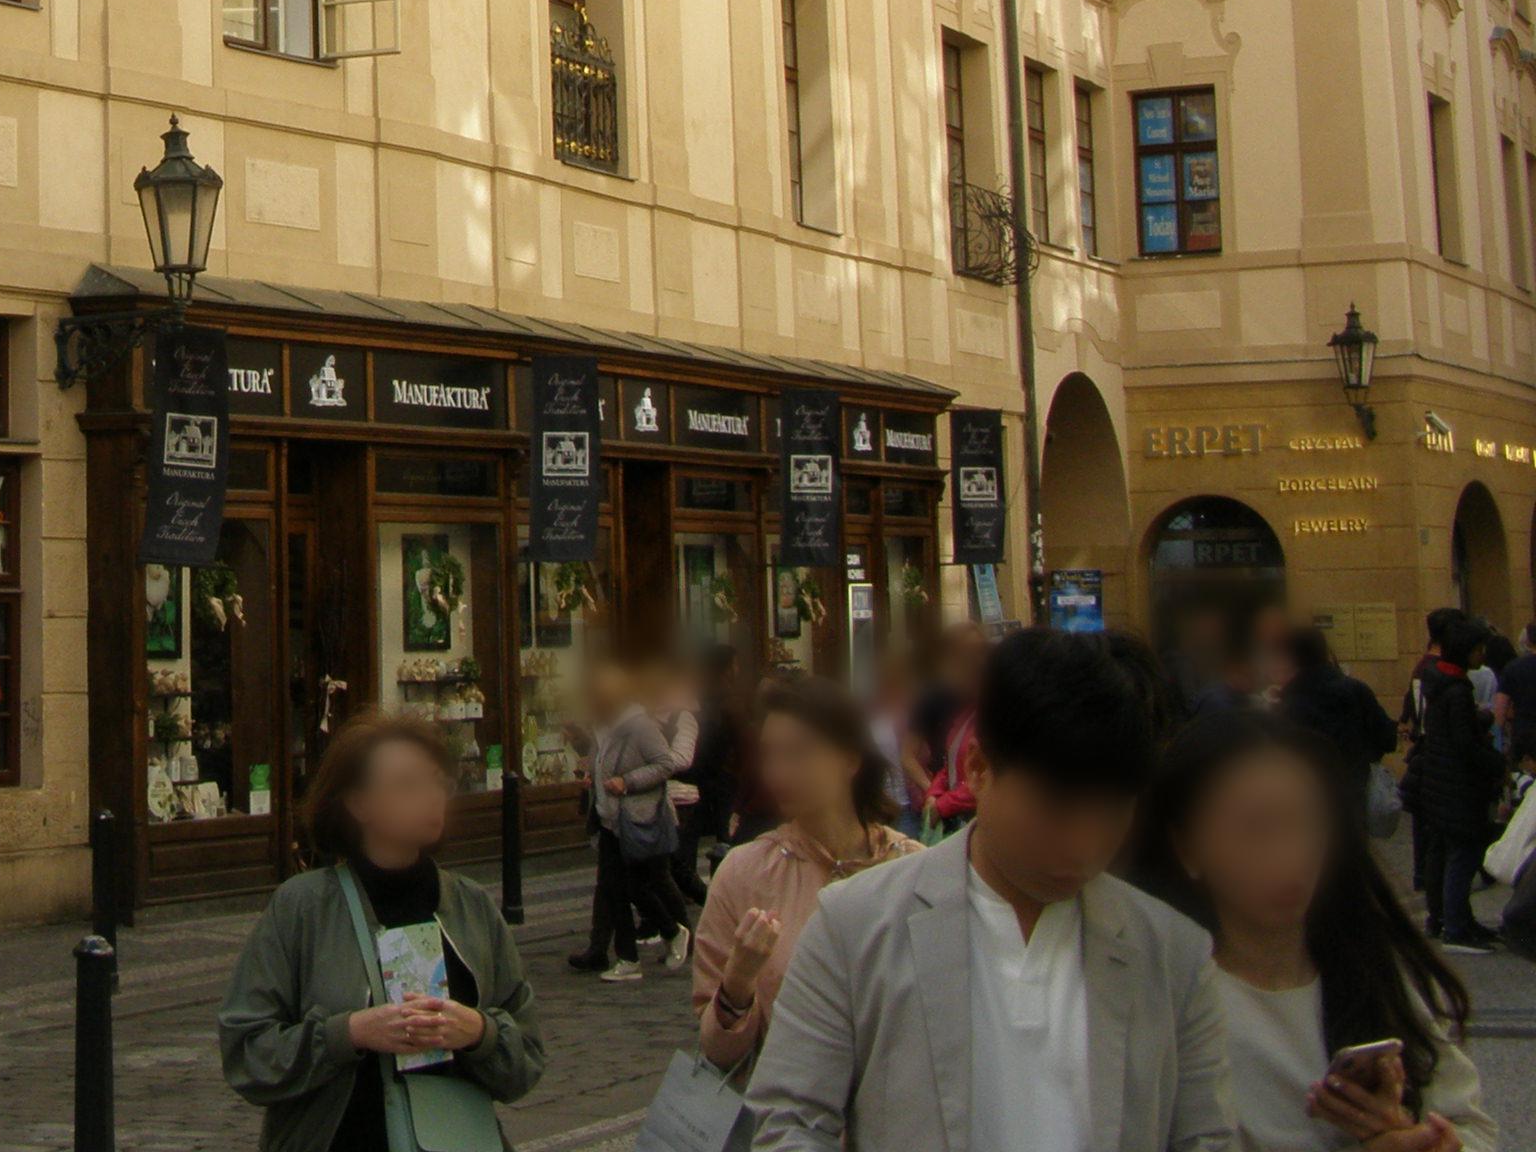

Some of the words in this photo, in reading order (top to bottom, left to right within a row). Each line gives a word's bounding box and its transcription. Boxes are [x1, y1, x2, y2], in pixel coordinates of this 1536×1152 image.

[1144, 423, 1265, 459] ERPET
[1279, 477, 1378, 493] PORCELAIN
[1294, 519, 1369, 535] JEWELRY
